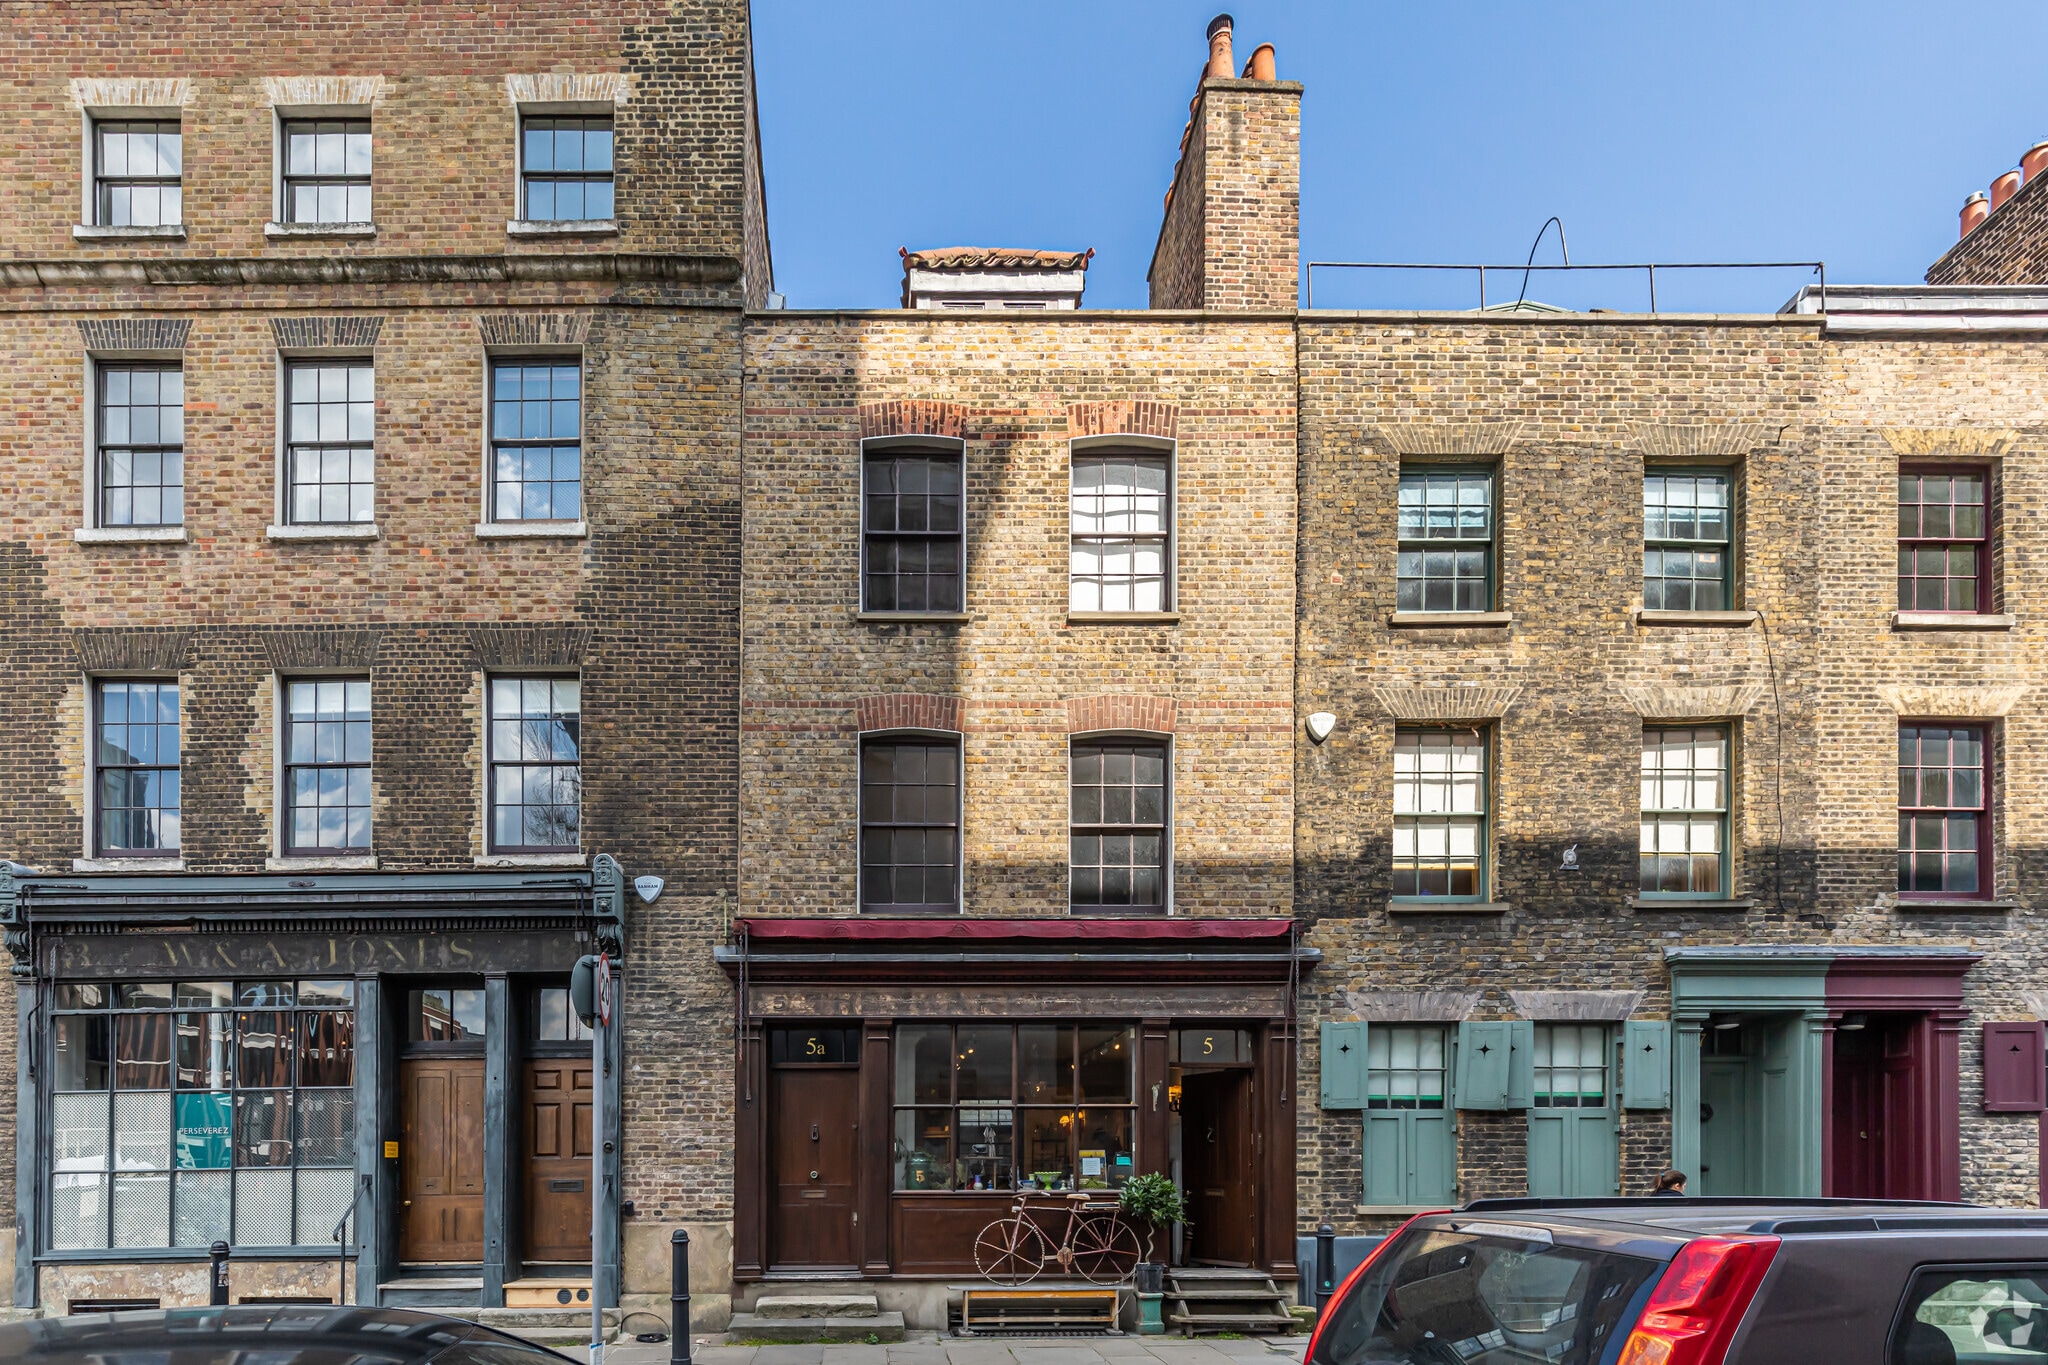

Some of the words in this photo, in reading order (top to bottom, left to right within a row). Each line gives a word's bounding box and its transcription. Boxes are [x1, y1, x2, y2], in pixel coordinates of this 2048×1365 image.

[601, 972, 609, 1006] 20
[806, 1037, 826, 1055] 5a
[1203, 1037, 1213, 1054] 5
